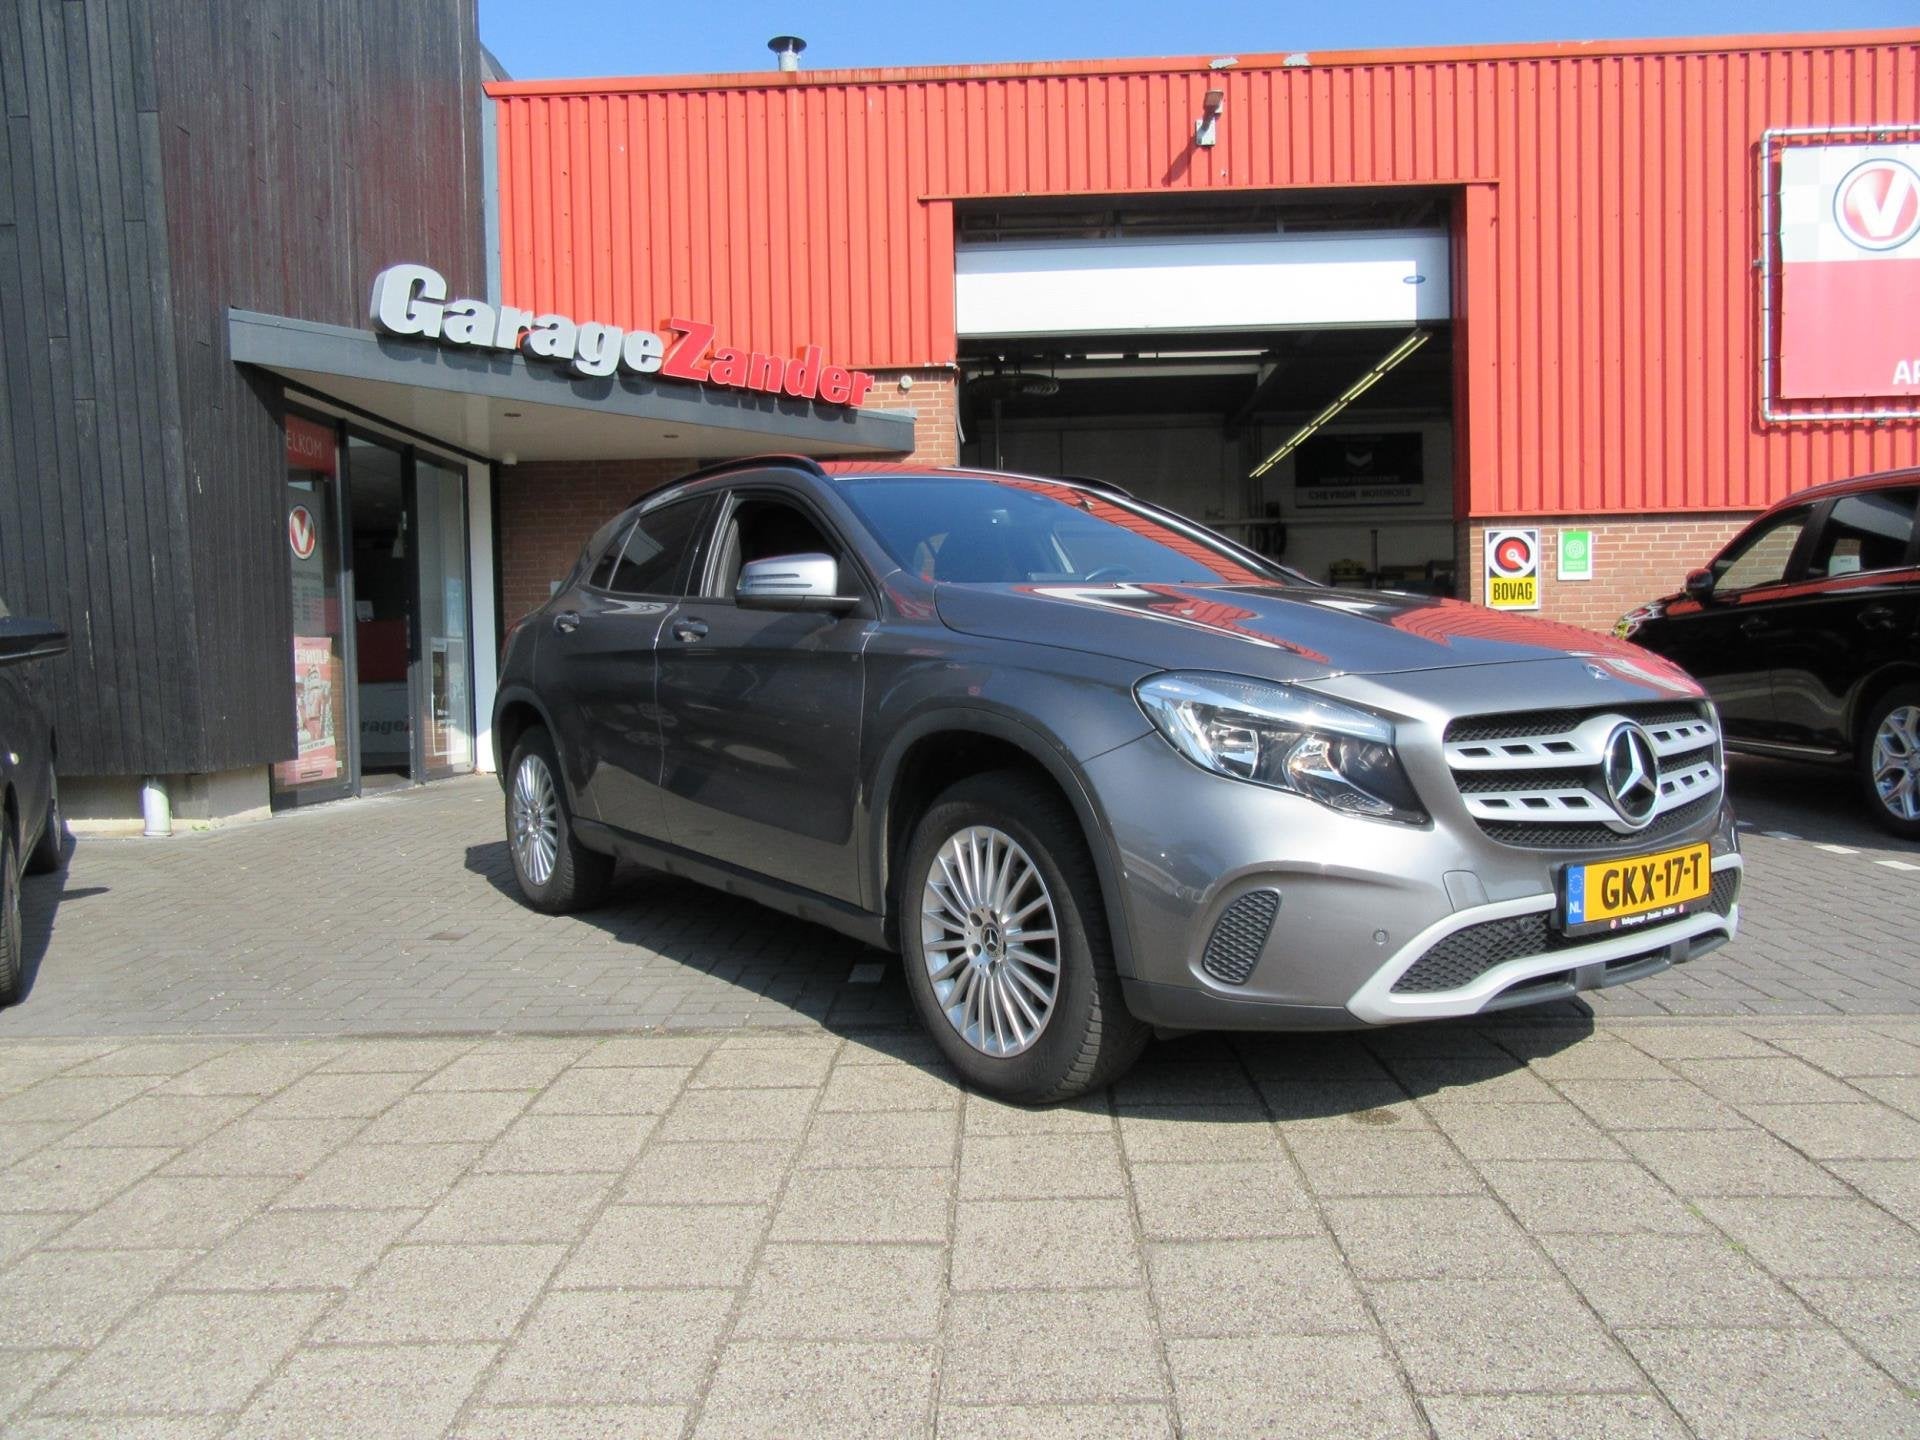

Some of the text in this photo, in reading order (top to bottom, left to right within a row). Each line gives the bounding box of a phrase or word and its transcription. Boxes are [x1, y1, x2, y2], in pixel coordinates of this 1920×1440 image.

[1493, 582, 1533, 601] BOVAG
[1602, 852, 1702, 911] GKX-17-T
[1569, 902, 1582, 914] NL
